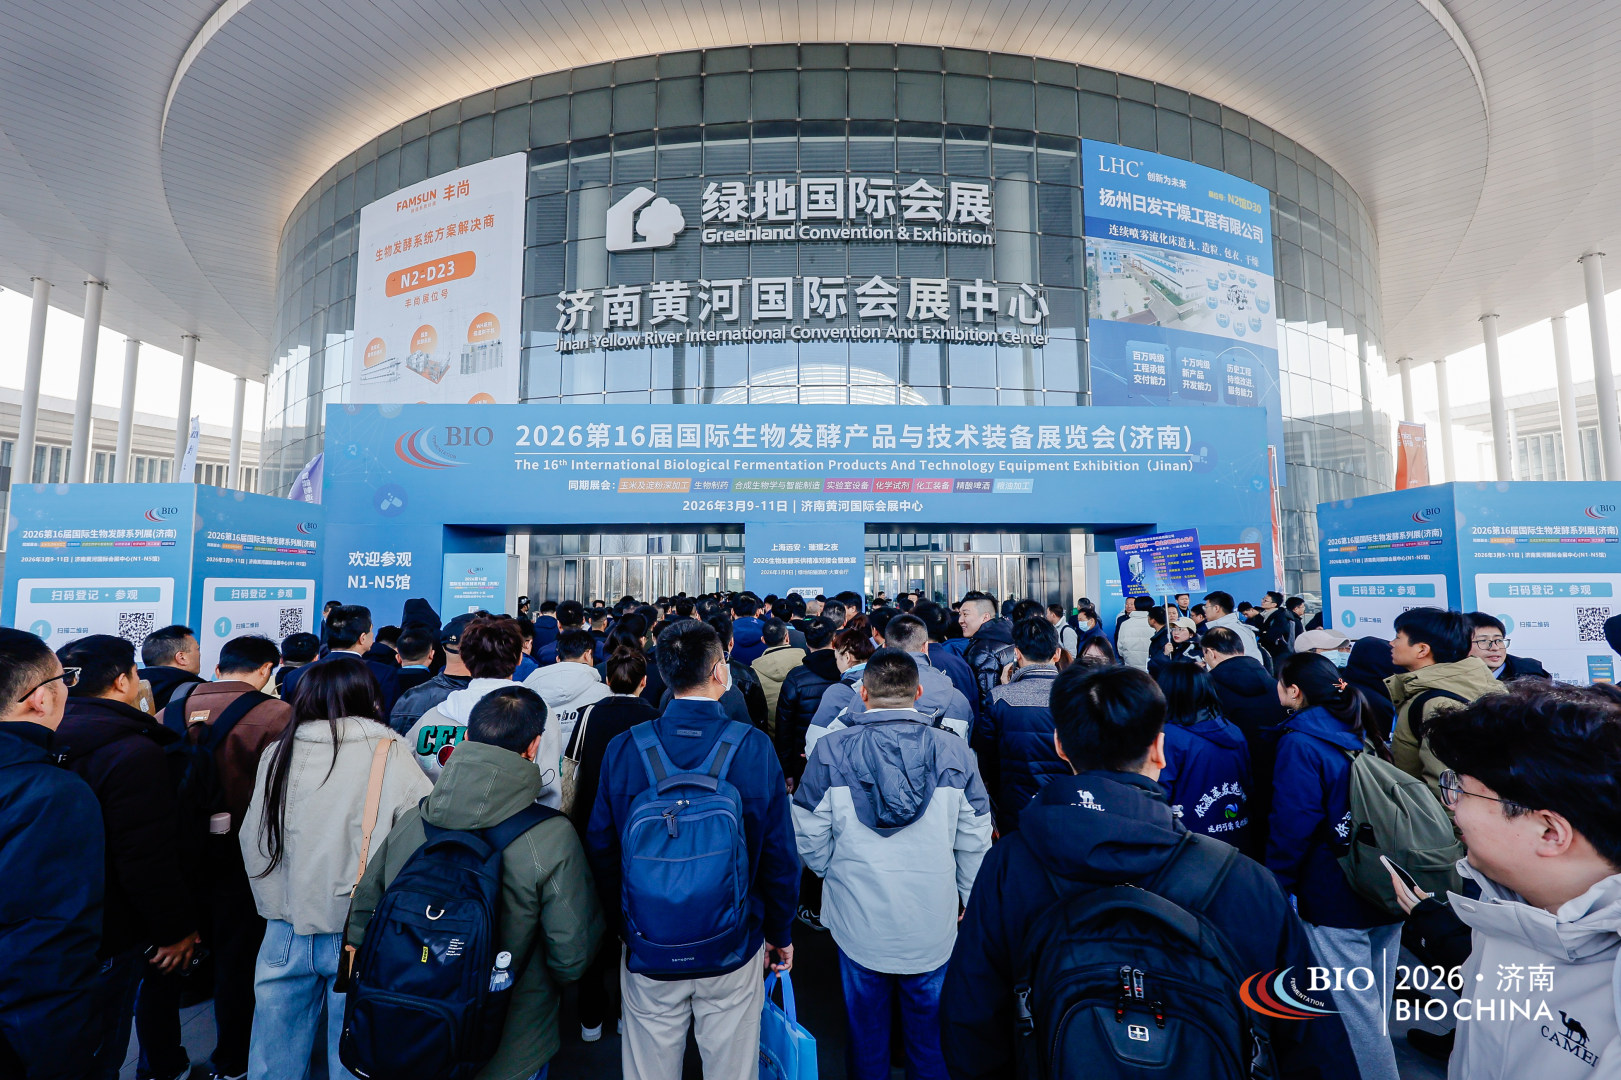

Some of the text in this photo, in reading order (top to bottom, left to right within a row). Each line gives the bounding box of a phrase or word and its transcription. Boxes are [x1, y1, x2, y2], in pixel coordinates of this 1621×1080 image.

[1146, 171, 1187, 190] 创新为未来
[396, 189, 437, 212] FAMSUN
[443, 179, 470, 201] 丰尚
[701, 177, 993, 225] 绿地国际会展
[1098, 188, 1264, 244] 扬州日发干燥工程有限公司
[375, 214, 495, 262] 生物发酵系统方案解决商
[702, 225, 993, 245] Greenland Convention & Exhibition
[400, 260, 455, 289] N2-D23
[404, 288, 449, 308] 丰尚展位号
[555, 275, 1050, 331] 济南黄河国际会展中心
[555, 324, 1050, 352] Jinan Yellow River International Convention And Exhibition Center
[1133, 374, 1166, 386] 交付能力
[1182, 368, 1205, 380] 新产品
[1182, 380, 1212, 392] 开发能力
[444, 426, 494, 447] BIO
[515, 422, 1193, 452] 2026第16届国际生物发酵产品与技术装备展览会(济南)
[514, 459, 539, 470] The
[543, 459, 568, 470] 16th
[571, 459, 660, 470] International
[664, 459, 730, 473] Biological
[734, 459, 824, 470] Fermentation
[828, 459, 887, 470] Products
[890, 459, 916, 470] And
[919, 459, 995, 473] Technology
[999, 459, 1070, 473] Equipment
[1073, 459, 1140, 471] Exhibition
[618, 480, 689, 490] 玉米及淀粉深加工
[693, 480, 729, 490] 生物制药
[734, 480, 821, 490] 合成生物学与智能制造
[826, 480, 869, 490] 实验室设备
[875, 480, 910, 490] 化学试剂
[916, 480, 950, 490] 化工装备
[956, 480, 991, 490] 精酿啤酒
[161, 507, 178, 515] BIO
[682, 500, 788, 512] 2026年3月9-11日
[801, 500, 923, 512] 济南黄河国际会展中心
[1425, 507, 1441, 516] BIO
[1599, 504, 1616, 512] BIO
[22, 529, 177, 539] 2026第16届国际生物发酵系列展(济南)
[1472, 525, 1619, 536] 2026第16届国际生物发酵系列展(济南)
[348, 551, 412, 567] 欢迎参观
[347, 573, 411, 590] N1-N5馆
[219, 620, 226, 633] 1
[1345, 612, 1351, 625] 1
